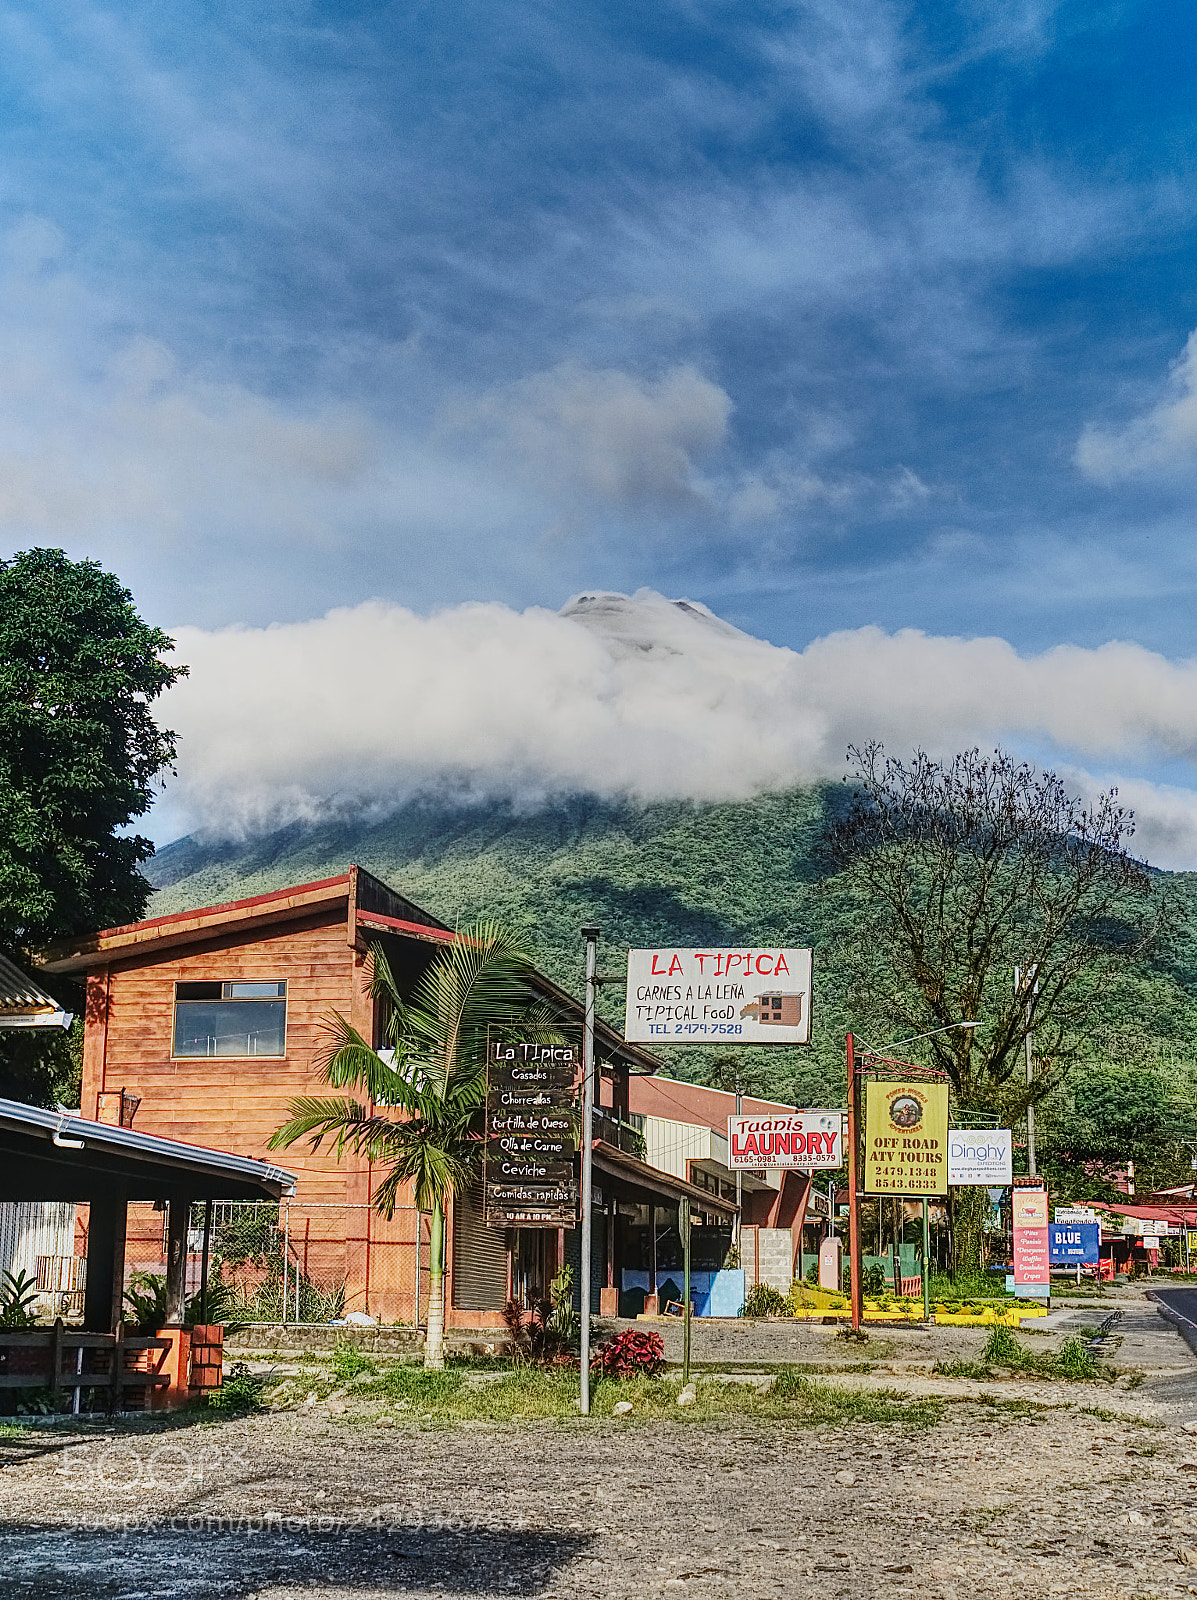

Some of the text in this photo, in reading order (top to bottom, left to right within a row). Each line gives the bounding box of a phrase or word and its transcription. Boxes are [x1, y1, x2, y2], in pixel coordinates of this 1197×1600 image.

[651, 953, 790, 977] LA TIPICA
[636, 983, 745, 1001] CARNES A LA LEÑA
[636, 1005, 698, 1021] TIPICAL
[649, 1023, 671, 1034] TEL
[495, 1043, 515, 1060] La
[511, 1068, 547, 1080] Casados
[501, 1093, 551, 1106] Chorreadas
[492, 1115, 526, 1131] tortilla
[527, 1116, 539, 1129] de
[736, 1116, 804, 1135] Tuanis
[500, 1138, 563, 1152] Olla de Carne
[732, 1132, 838, 1156] LAUNDRY
[873, 1137, 939, 1150] OFF ROAD
[734, 1154, 836, 1163] 6165-0981 8335-0579
[869, 1151, 943, 1164] ATV TOURS
[951, 1143, 1006, 1161] Dinghy
[501, 1162, 547, 1177] Ceviche
[875, 1166, 937, 1177] 2479.1348
[875, 1178, 937, 1189] 8543.6333
[493, 1187, 569, 1203] Comidas rapidas
[1055, 1232, 1081, 1244] BLUE
